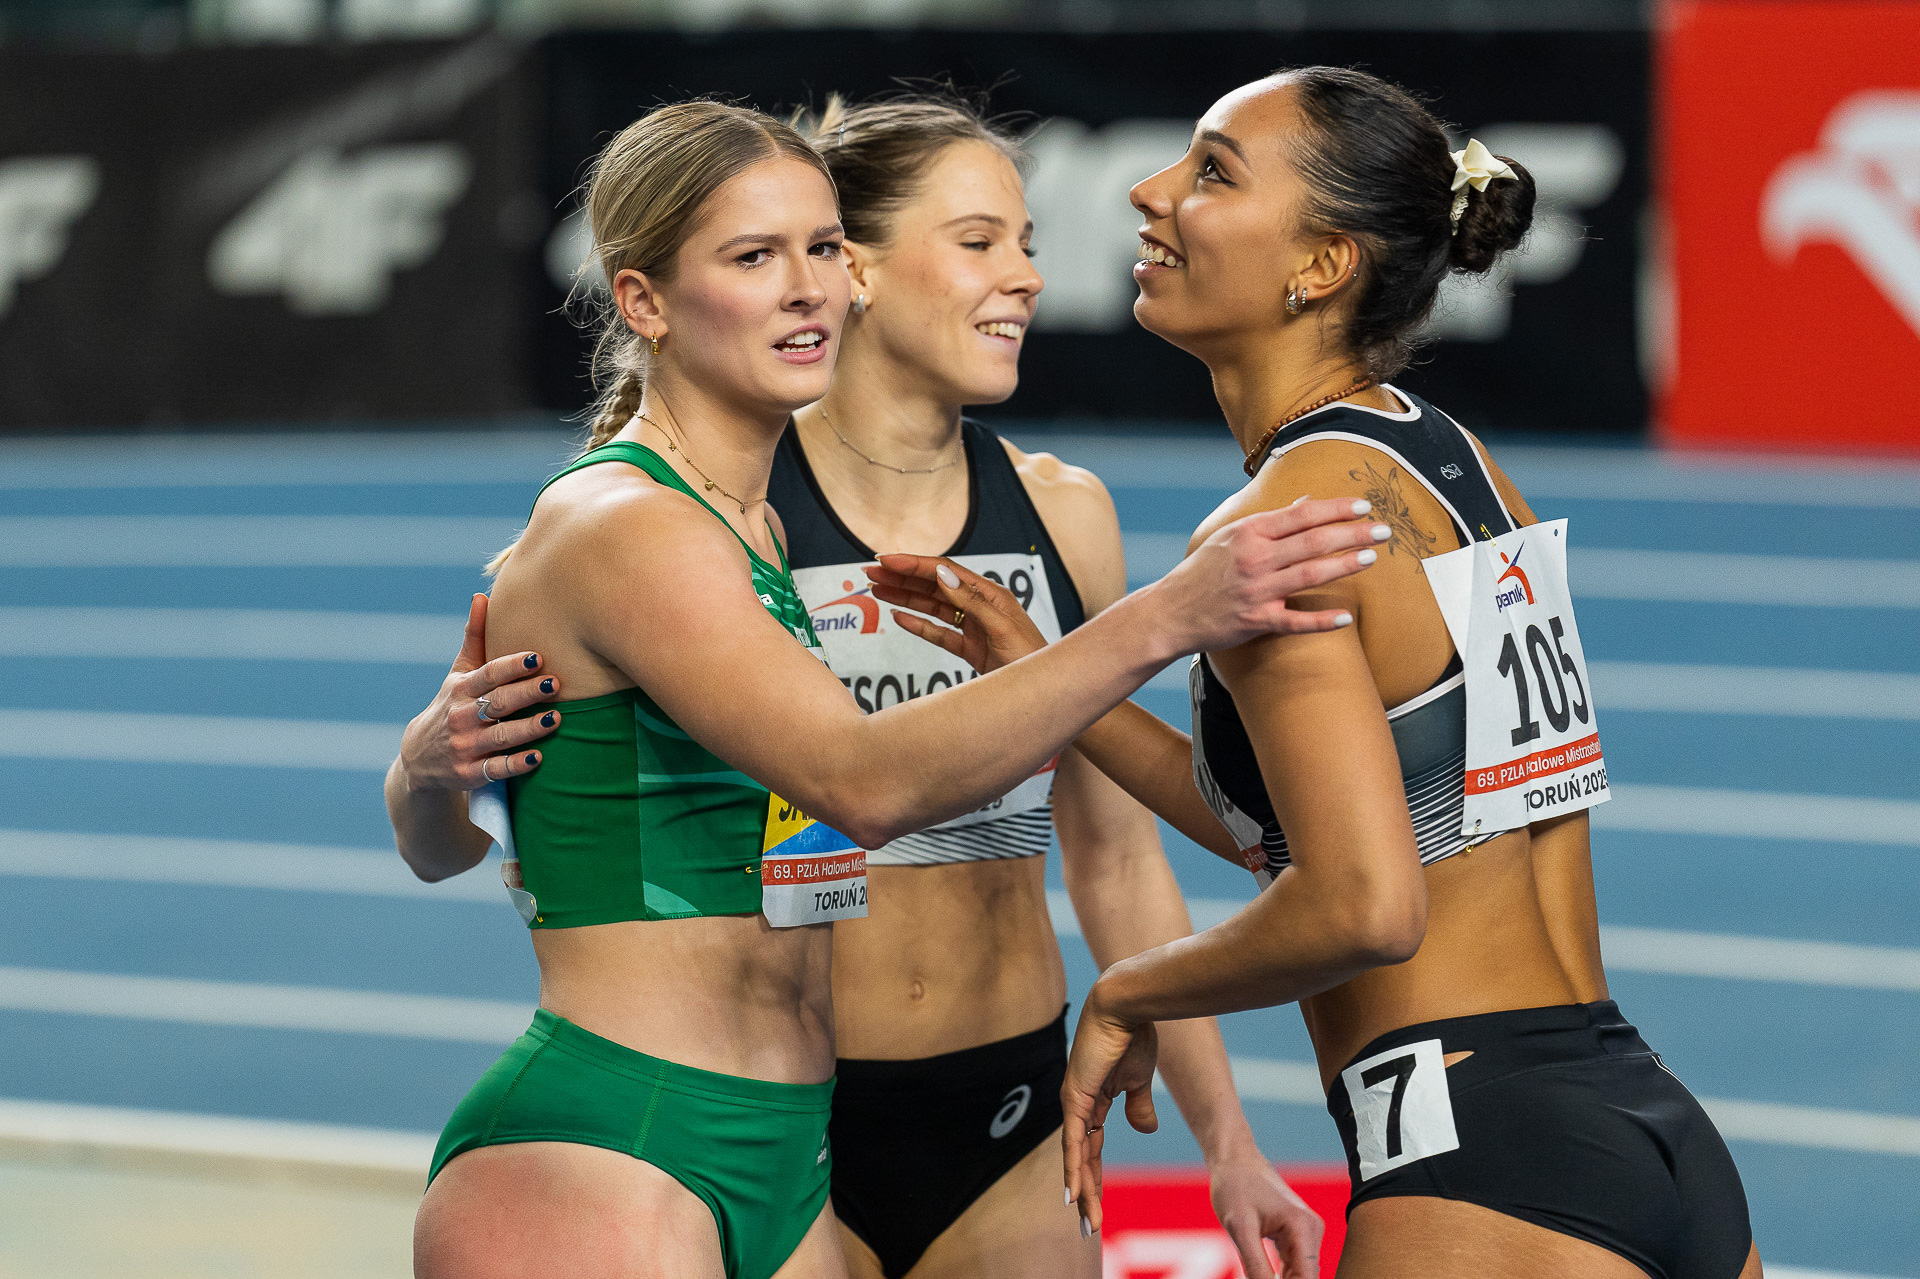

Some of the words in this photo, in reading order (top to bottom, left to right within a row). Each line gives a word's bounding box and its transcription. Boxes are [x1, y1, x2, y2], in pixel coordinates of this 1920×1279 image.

[1496, 615, 1589, 747] 105
[1477, 771, 1498, 788] 69.
[1500, 765, 1525, 783] PZLA
[1526, 754, 1565, 776] Halowe
[1523, 773, 1582, 813] TORUŃ
[773, 864, 794, 879] 69.
[797, 863, 820, 878] PZLA
[821, 860, 850, 876] Halowe
[814, 881, 857, 911] TORUŃ
[1360, 1053, 1417, 1160] 7
